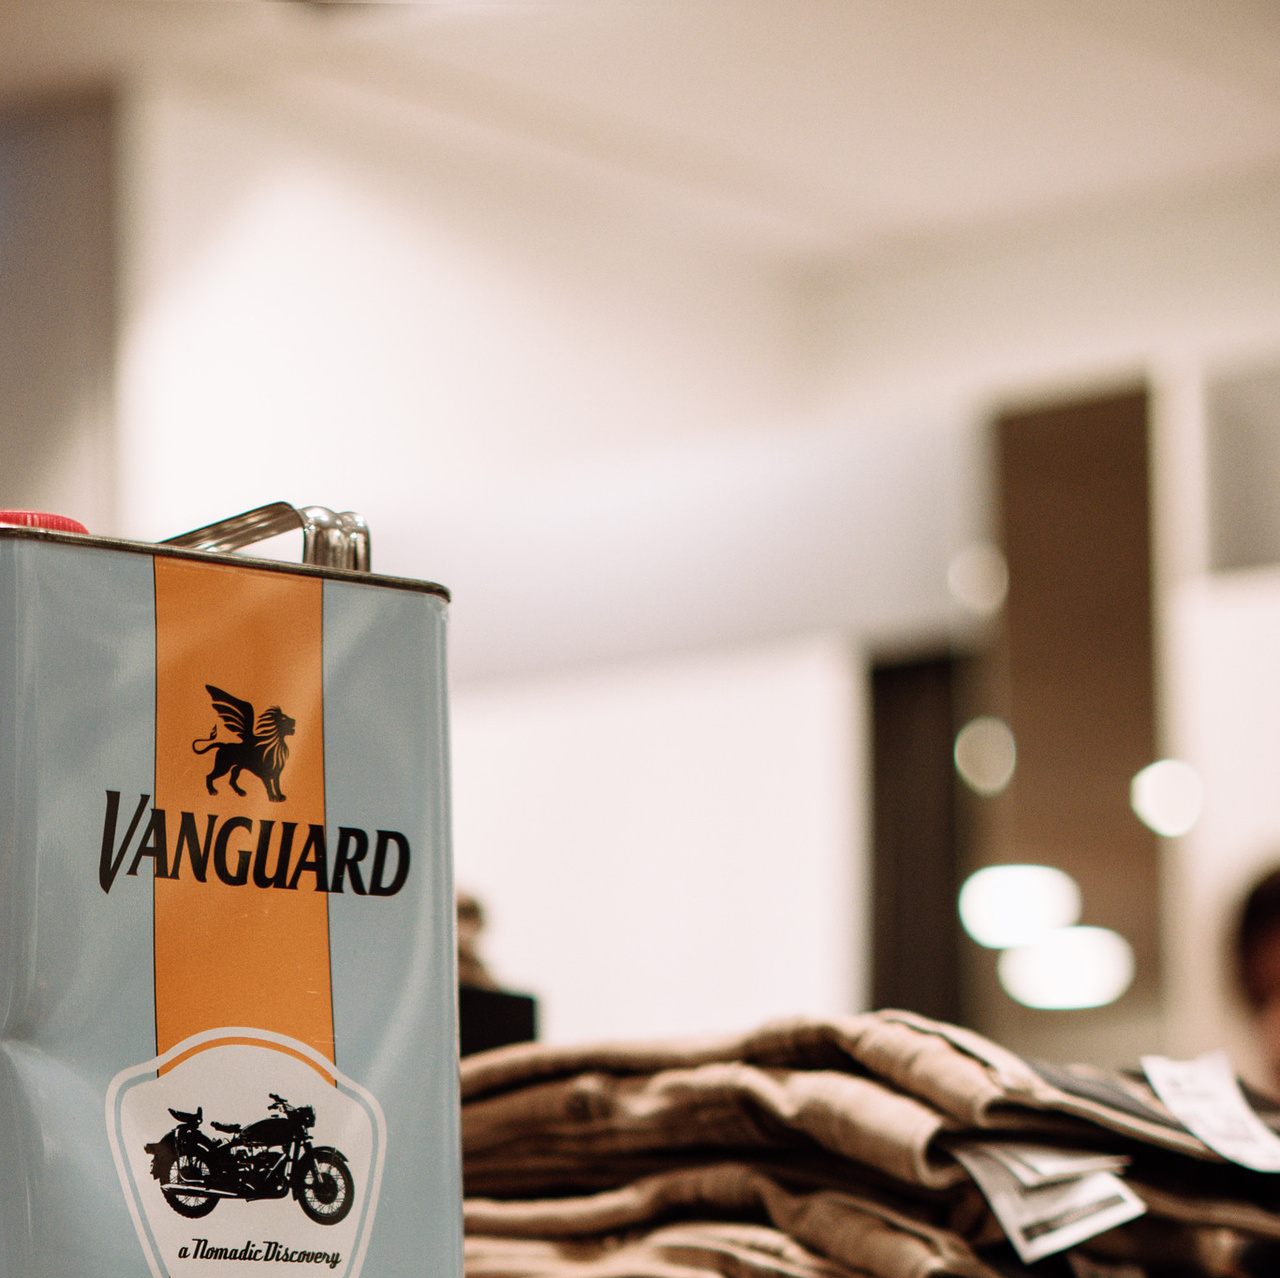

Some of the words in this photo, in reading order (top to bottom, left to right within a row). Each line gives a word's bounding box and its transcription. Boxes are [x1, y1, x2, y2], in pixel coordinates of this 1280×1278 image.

[98, 790, 411, 898] VANGUARD
[178, 1245, 190, 1259] a
[191, 1238, 263, 1261] Nomadic
[263, 1240, 342, 1269] Discovery
